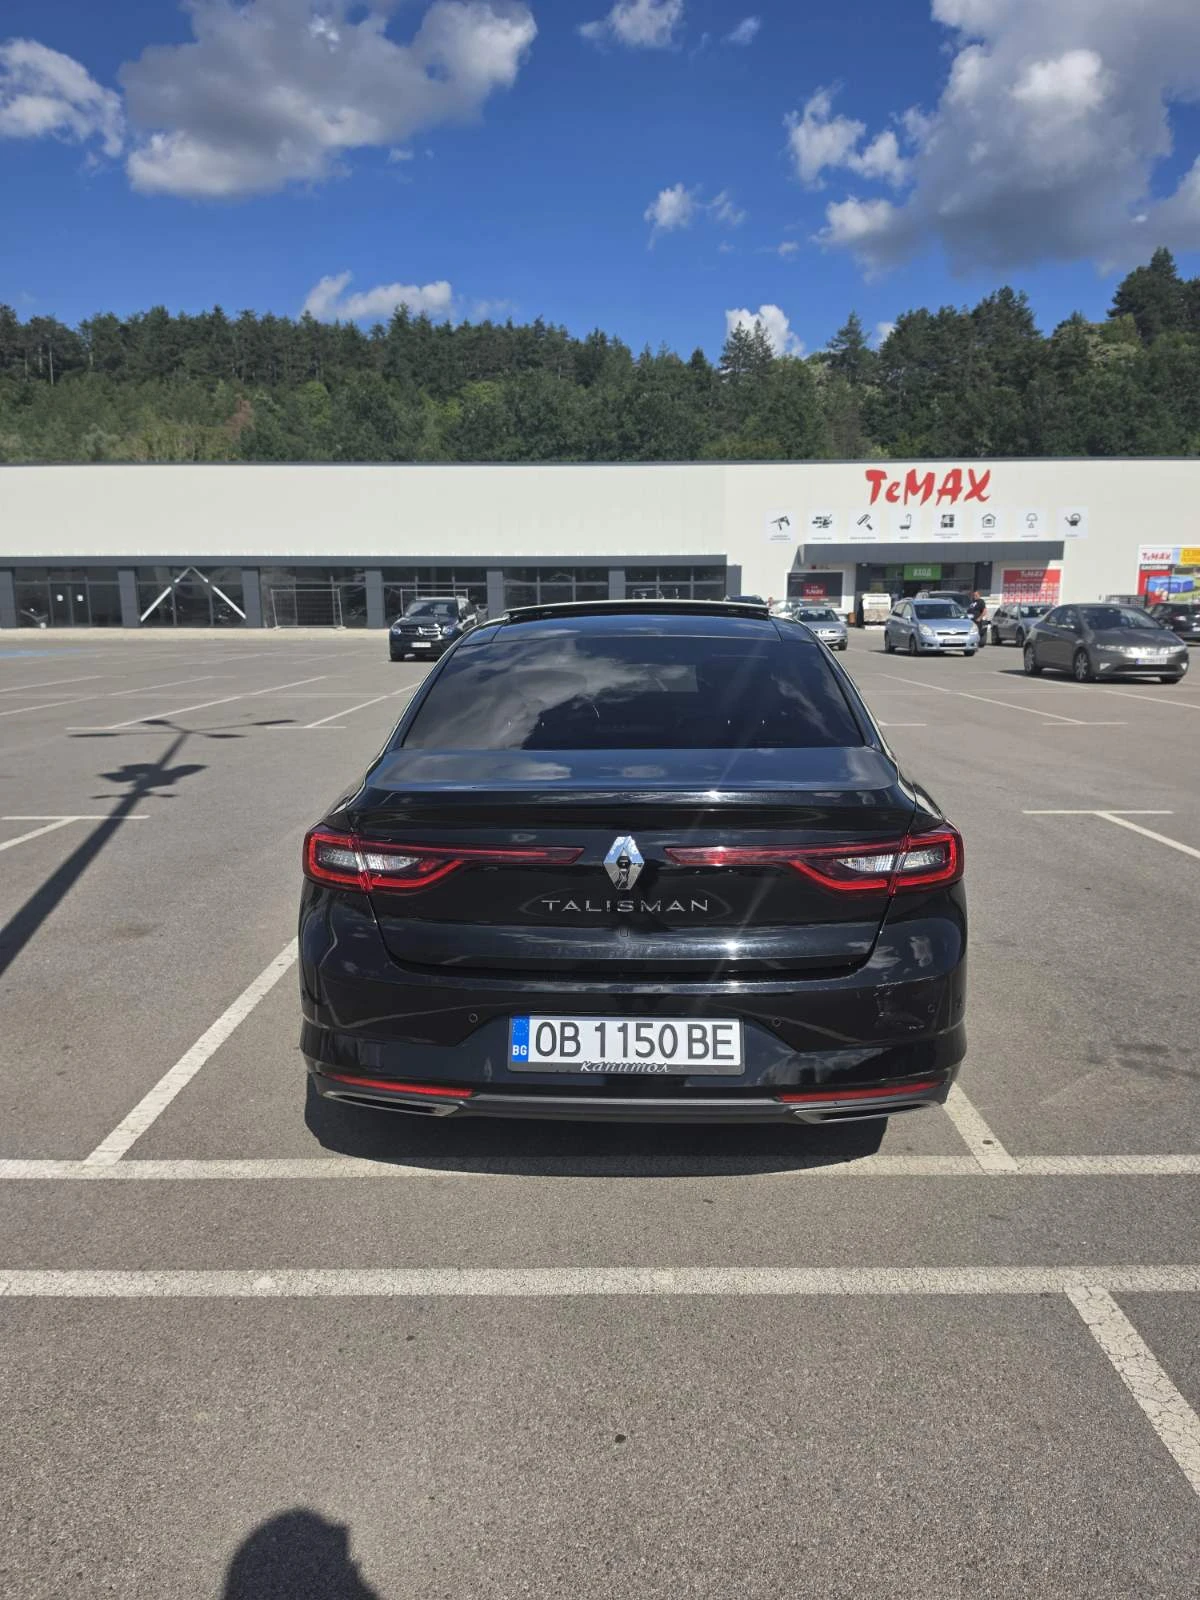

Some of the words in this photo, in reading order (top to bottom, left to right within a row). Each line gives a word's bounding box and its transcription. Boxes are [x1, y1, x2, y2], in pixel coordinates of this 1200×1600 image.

[865, 468, 991, 506] TeMAX
[541, 899, 709, 913] TALISMAN
[512, 1045, 527, 1056] BG
[535, 1021, 581, 1057] OB
[594, 1022, 678, 1059] 1150
[688, 1024, 735, 1060] BE
